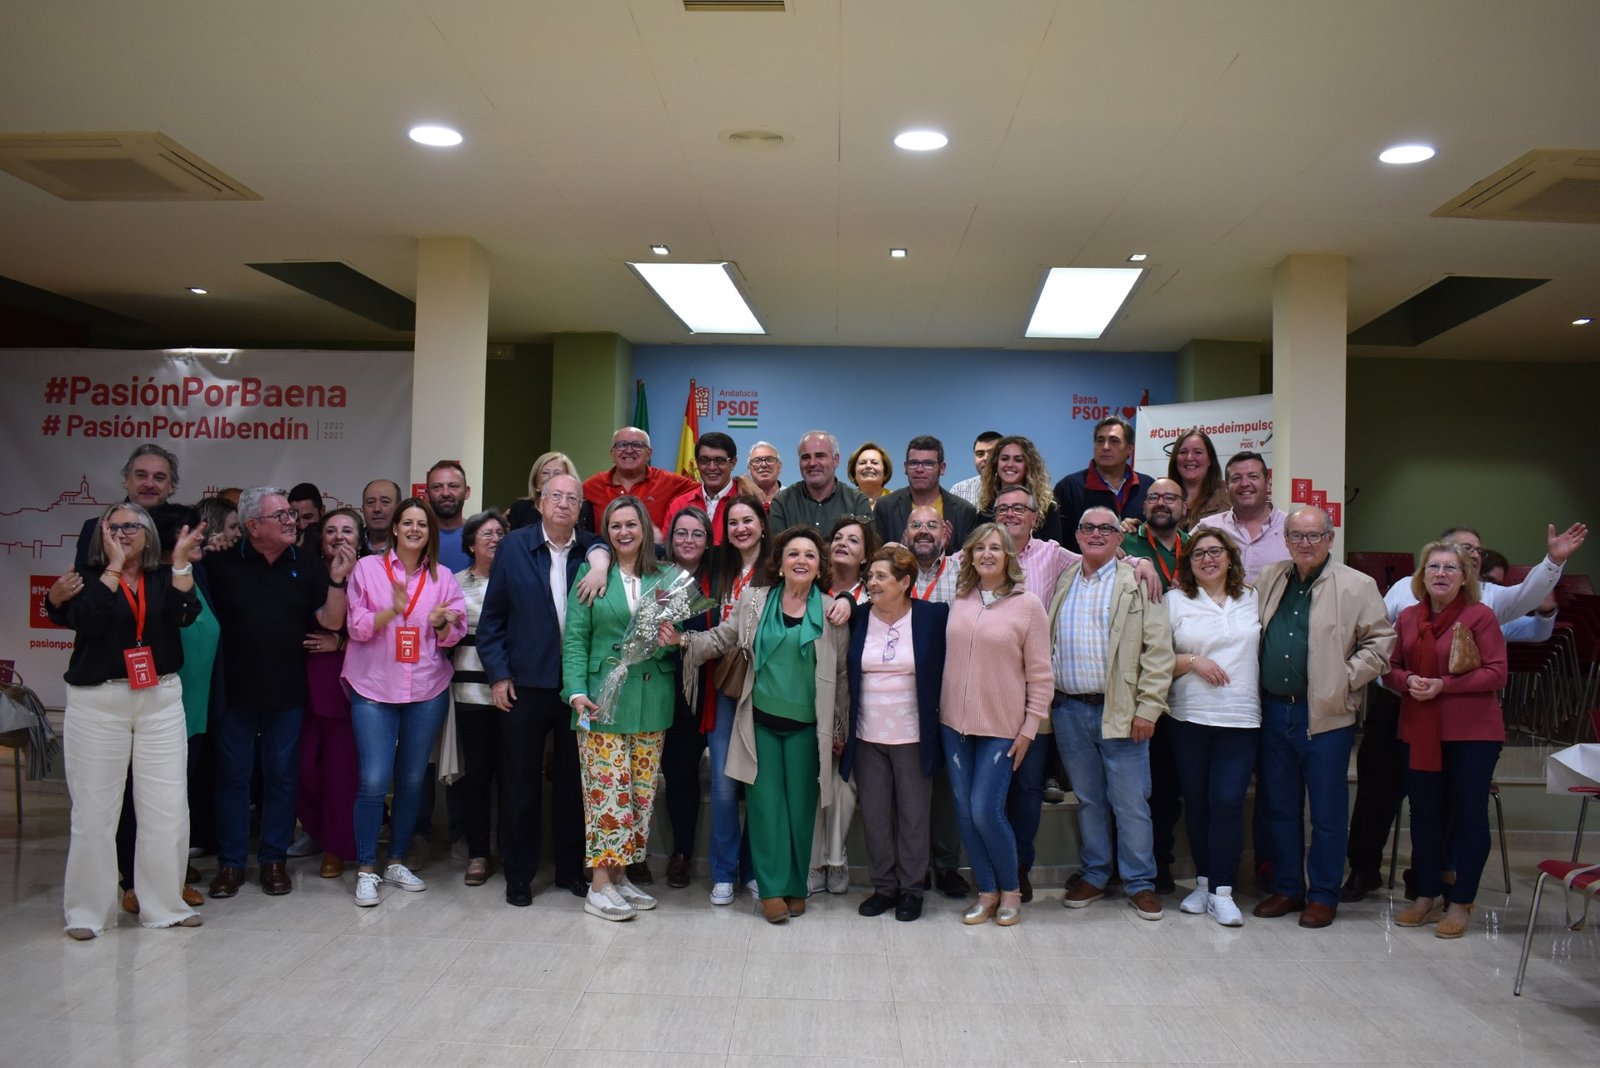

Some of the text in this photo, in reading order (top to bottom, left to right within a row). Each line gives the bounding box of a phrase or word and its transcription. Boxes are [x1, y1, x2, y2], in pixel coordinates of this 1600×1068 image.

[44, 375, 347, 408] #PasiónPorBaena
[1072, 394, 1098, 404] Baena
[717, 400, 759, 416] PSOE
[1072, 406, 1110, 420] PSOE
[323, 422, 345, 430] 2023
[323, 432, 344, 440] 2027
[1240, 441, 1254, 449] PSOE
